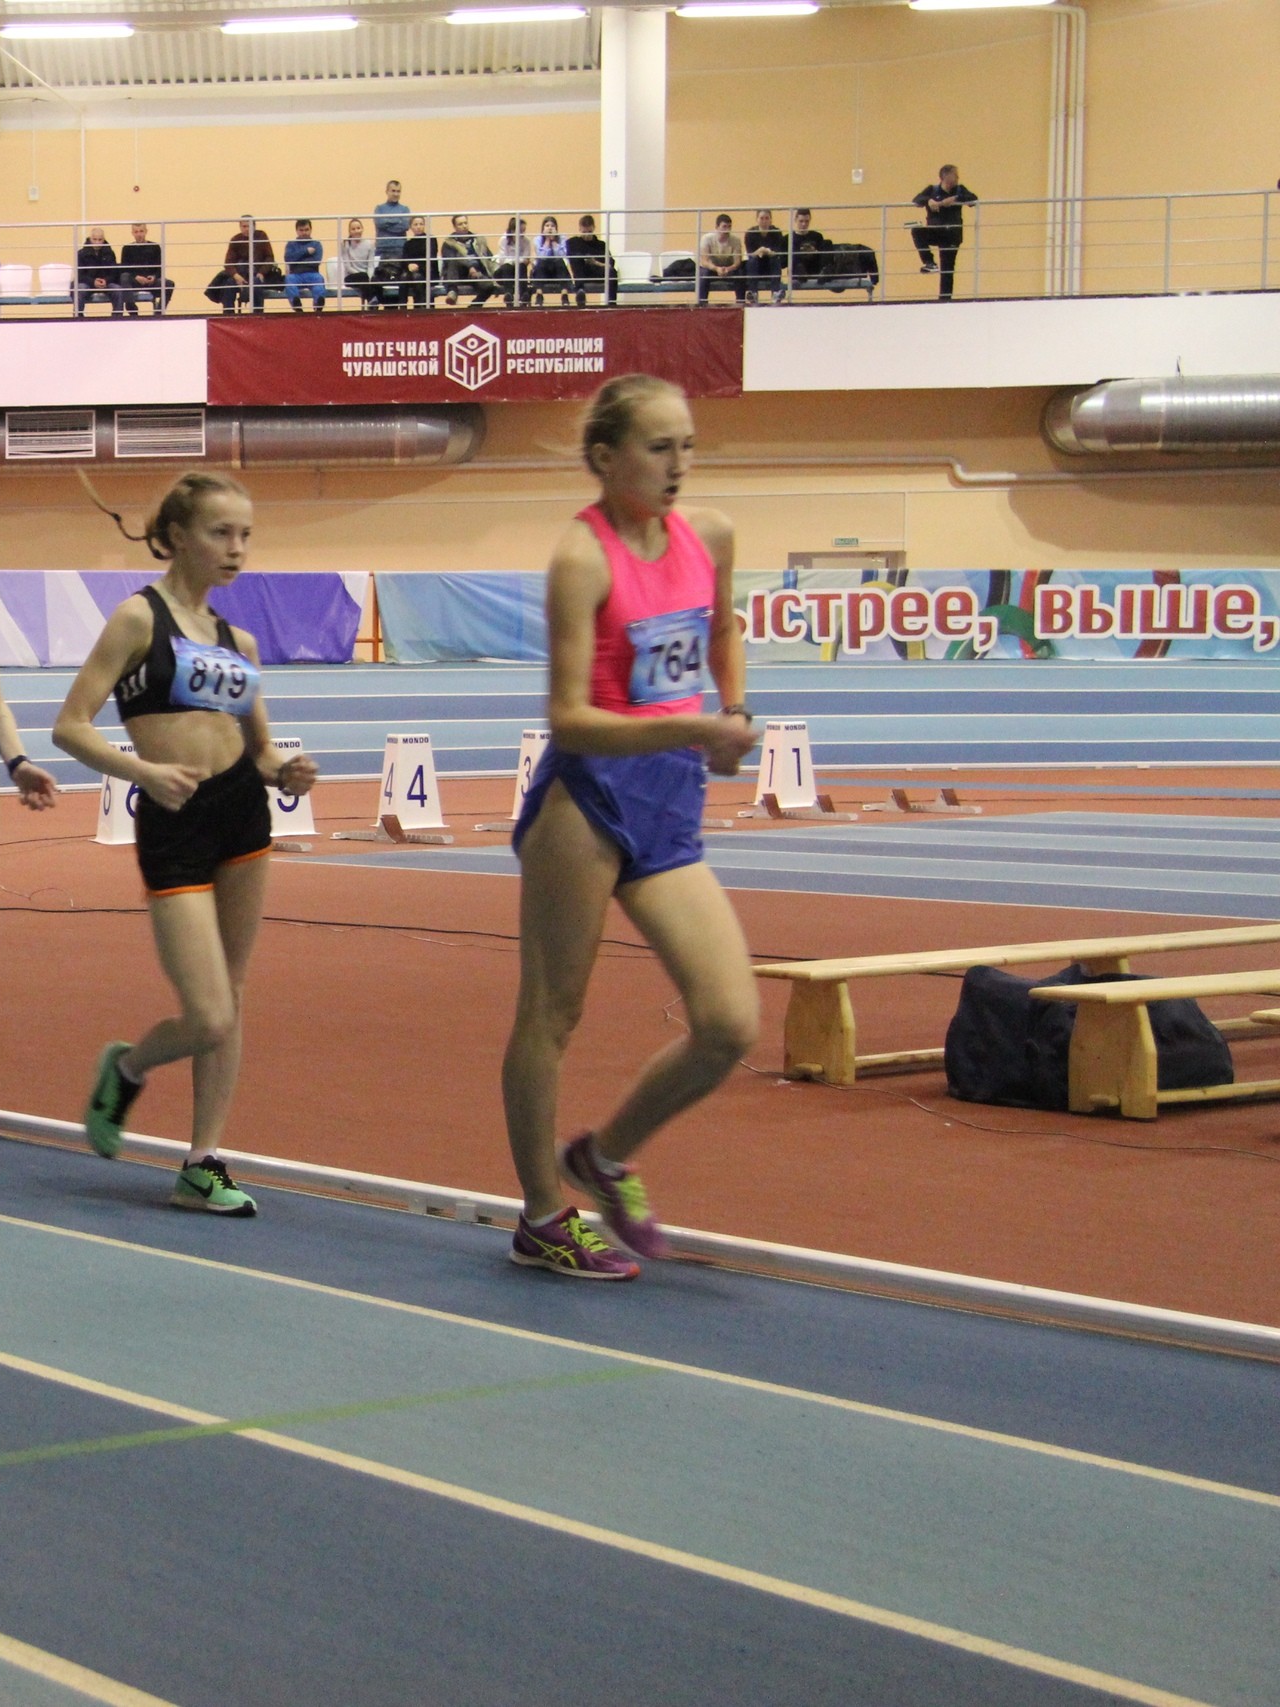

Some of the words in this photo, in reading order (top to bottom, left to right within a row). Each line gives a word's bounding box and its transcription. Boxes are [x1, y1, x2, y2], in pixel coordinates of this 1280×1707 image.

[342, 341, 439, 357] ИПОТЕЧНАЯ
[506, 338, 604, 355] КОРПОРАЦИЯ
[342, 358, 439, 377] ЧУВАШСКОЙ
[506, 358, 604, 374] РЕСПУБЛИКИ
[733, 587, 997, 653] ыстрее,
[1036, 586, 1278, 651] выше,
[189, 656, 246, 699] 819
[646, 635, 702, 687] 764
[401, 736, 430, 745] MONDO
[406, 764, 428, 808] 4
[791, 747, 802, 787] 1
